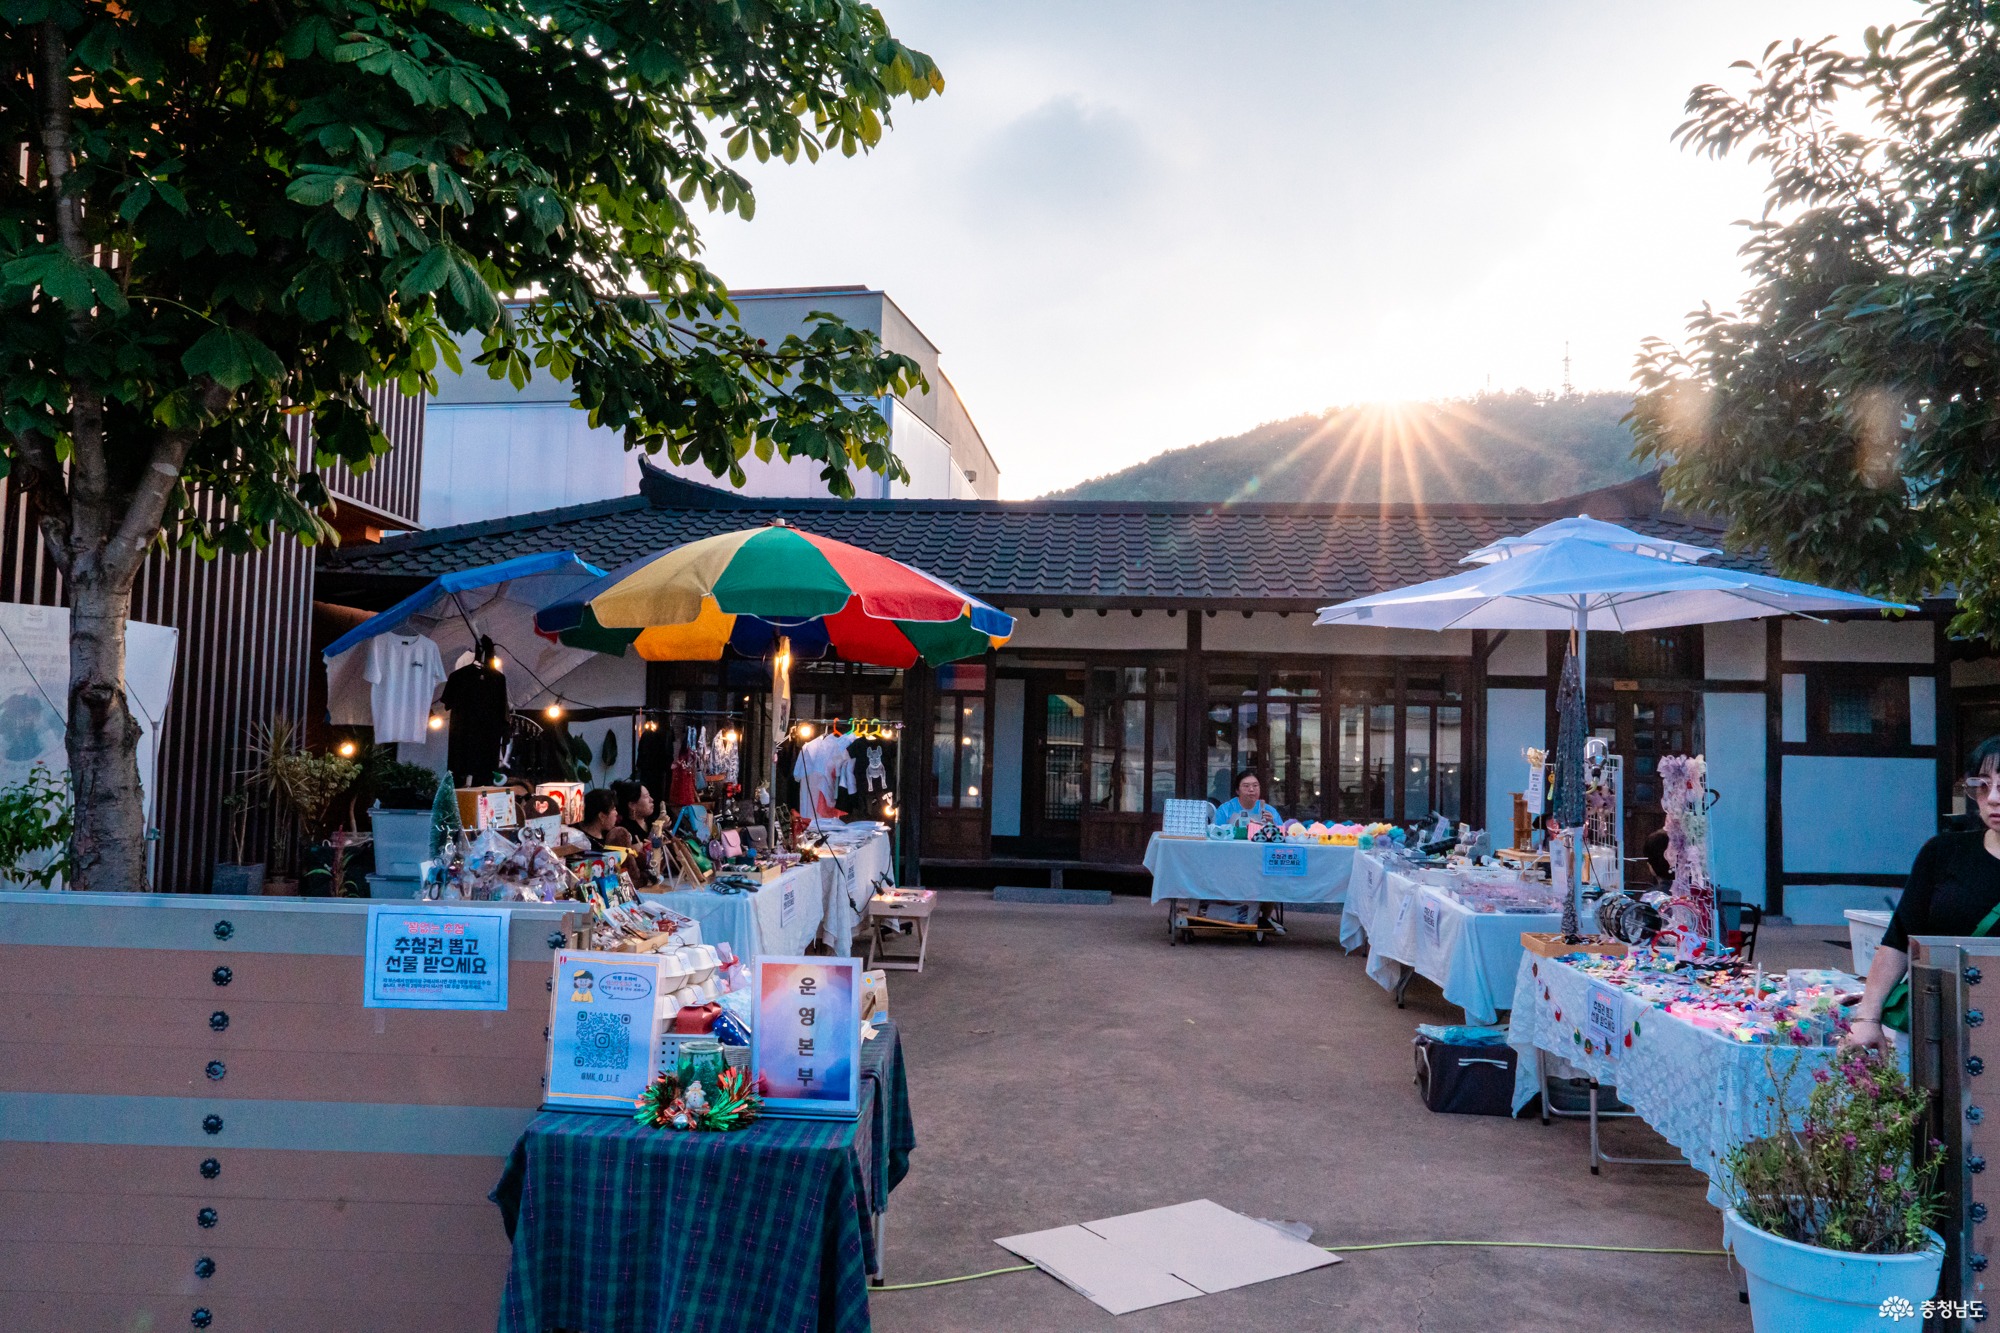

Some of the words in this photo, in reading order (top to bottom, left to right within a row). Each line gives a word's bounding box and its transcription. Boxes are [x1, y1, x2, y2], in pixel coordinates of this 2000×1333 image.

[394, 937, 443, 955] 추첨권
[449, 937, 479, 956] 뽑고
[385, 955, 419, 974] 선물
[423, 956, 488, 975] 받으세요
[797, 976, 817, 1088] 운영본부
